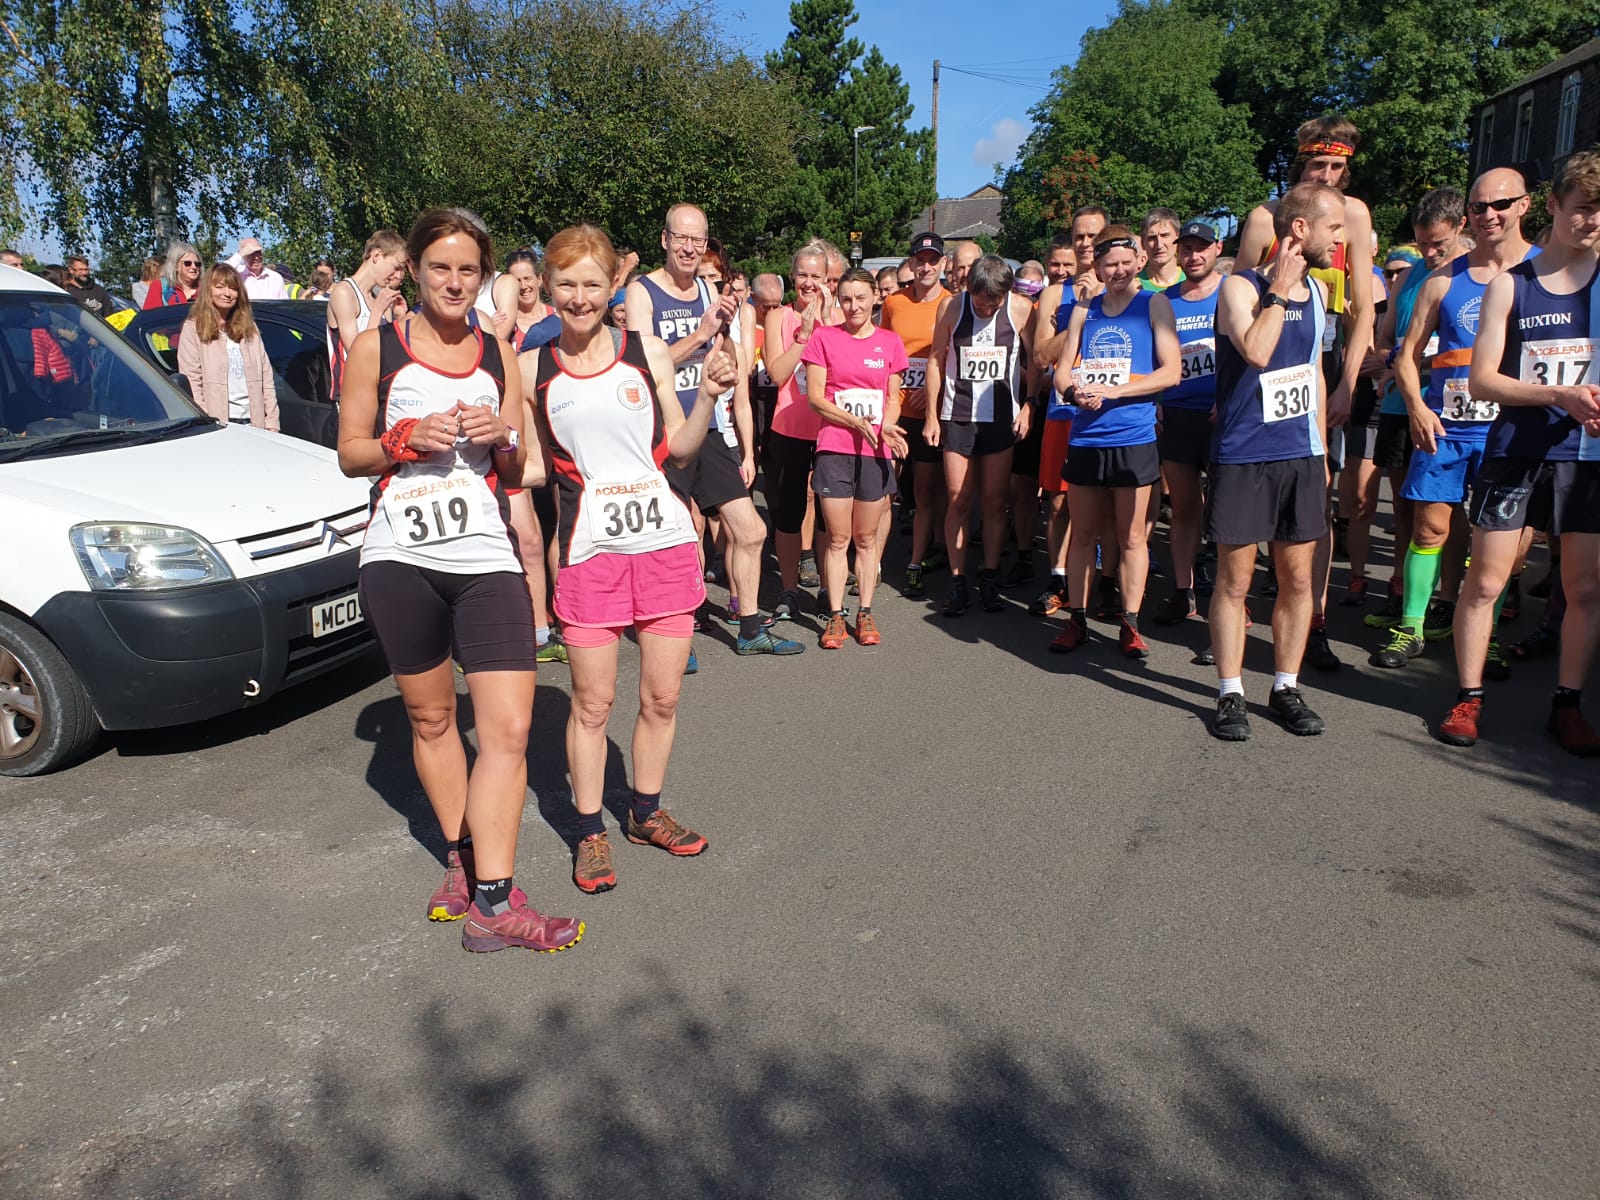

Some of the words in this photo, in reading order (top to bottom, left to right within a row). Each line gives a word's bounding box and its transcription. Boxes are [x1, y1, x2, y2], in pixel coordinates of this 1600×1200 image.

[661, 308, 693, 319] BUXTON
[1519, 312, 1572, 330] BUXTON
[658, 317, 701, 340] PET
[1529, 344, 1595, 357] ACCELERATE
[677, 365, 700, 388] 32
[967, 360, 999, 379] 290
[1181, 352, 1215, 379] 344
[1532, 360, 1591, 386] 317
[1267, 369, 1312, 386] ACCELERATE
[1273, 384, 1310, 418] 330
[393, 478, 470, 501] ACCELERATE
[595, 479, 662, 497] ACCELERATE
[404, 497, 468, 541] 319
[603, 497, 664, 536] 304
